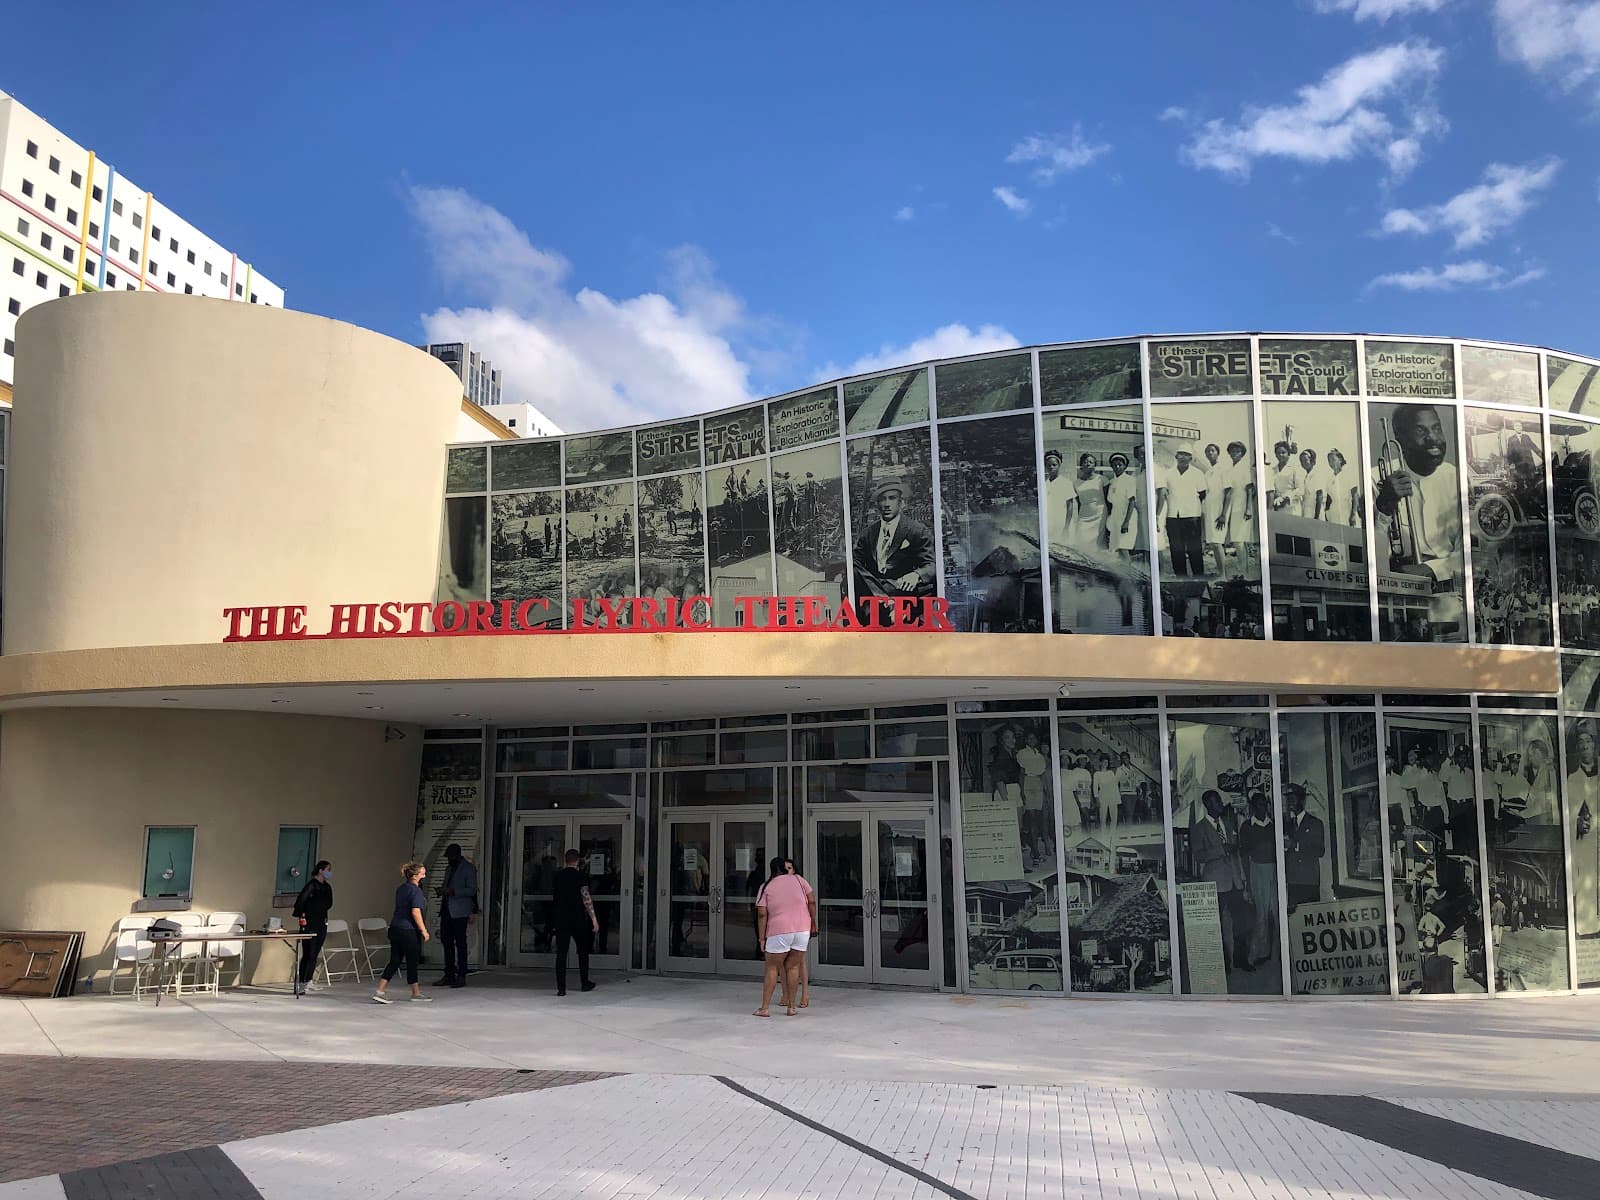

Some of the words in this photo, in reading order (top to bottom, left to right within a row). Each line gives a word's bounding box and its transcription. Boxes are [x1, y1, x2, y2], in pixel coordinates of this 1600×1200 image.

[1159, 347, 1169, 356] If
[1172, 347, 1206, 356] these
[1378, 353, 1393, 365] An
[1395, 353, 1436, 366] Historic
[1163, 353, 1312, 377] STREETS
[1306, 365, 1345, 377] could
[1371, 368, 1433, 382] Exploration
[1435, 370, 1448, 381] of
[1377, 383, 1408, 395] Black
[1411, 384, 1441, 396] Miami
[781, 409, 792, 420] An
[793, 400, 824, 417] Historic
[776, 415, 823, 434] Exploration
[824, 412, 833, 423] of
[1070, 418, 1138, 431] CHRISTIAN
[1154, 426, 1198, 440] OSPITAL
[641, 423, 740, 459] STREETS
[647, 430, 670, 441] these
[735, 428, 763, 443] could
[780, 433, 802, 447] Black
[804, 428, 830, 441] Miami
[1305, 570, 1353, 583] CLYDE'S
[223, 605, 308, 640] THE
[326, 597, 550, 637] HISTORIC
[572, 595, 713, 632] LYRIC
[735, 595, 955, 632] THEATER
[1304, 907, 1380, 927] MANAGED
[1295, 955, 1363, 973] COLLECTION
[1303, 978, 1327, 990] 1163
